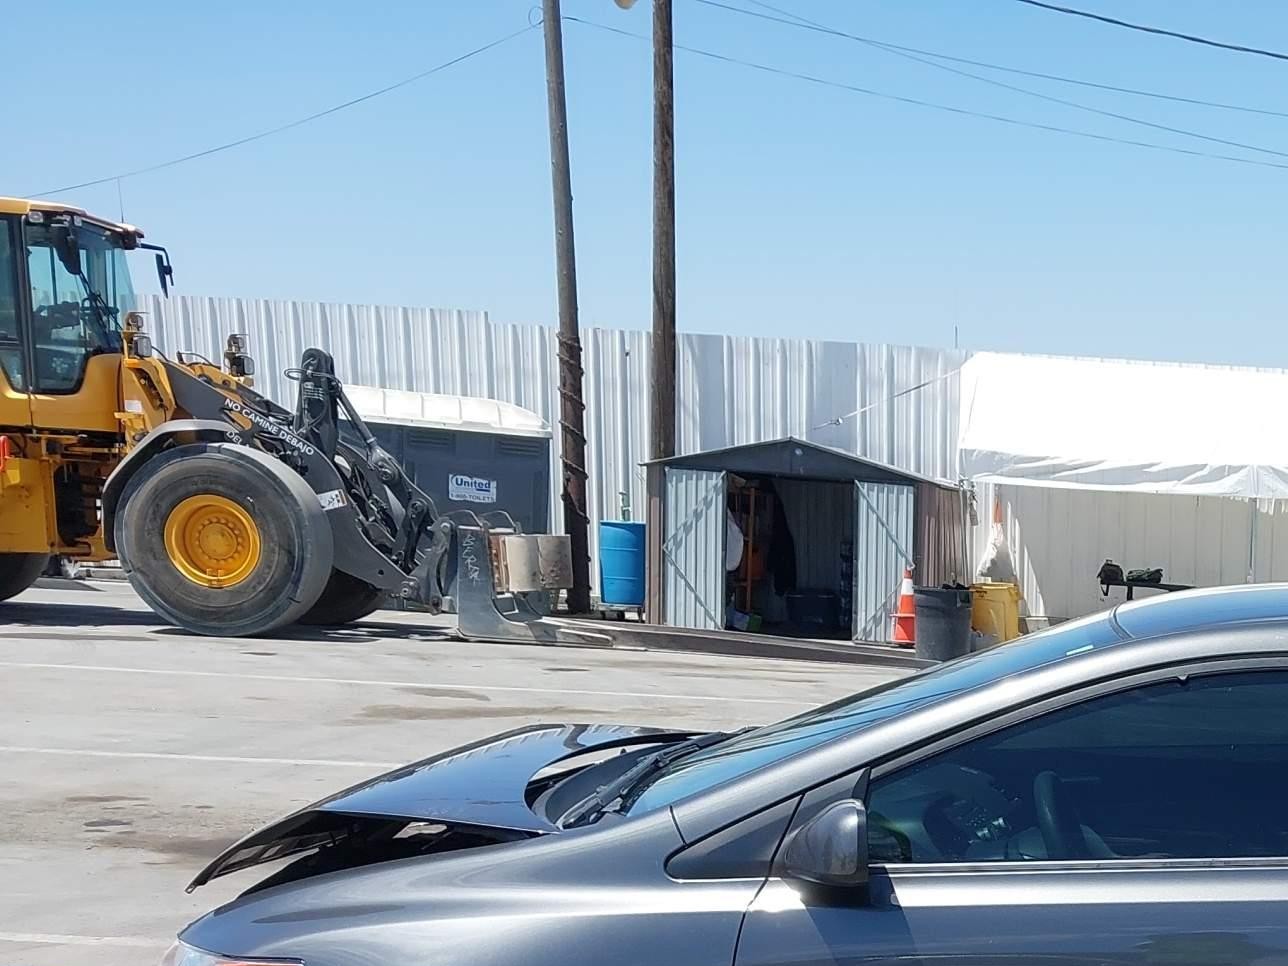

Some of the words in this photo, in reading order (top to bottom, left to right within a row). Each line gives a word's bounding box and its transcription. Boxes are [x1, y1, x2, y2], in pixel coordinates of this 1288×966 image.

[225, 398, 241, 411] NO
[242, 409, 279, 434] CAMINE
[279, 430, 314, 455] DEBAJO
[455, 477, 491, 489] United
